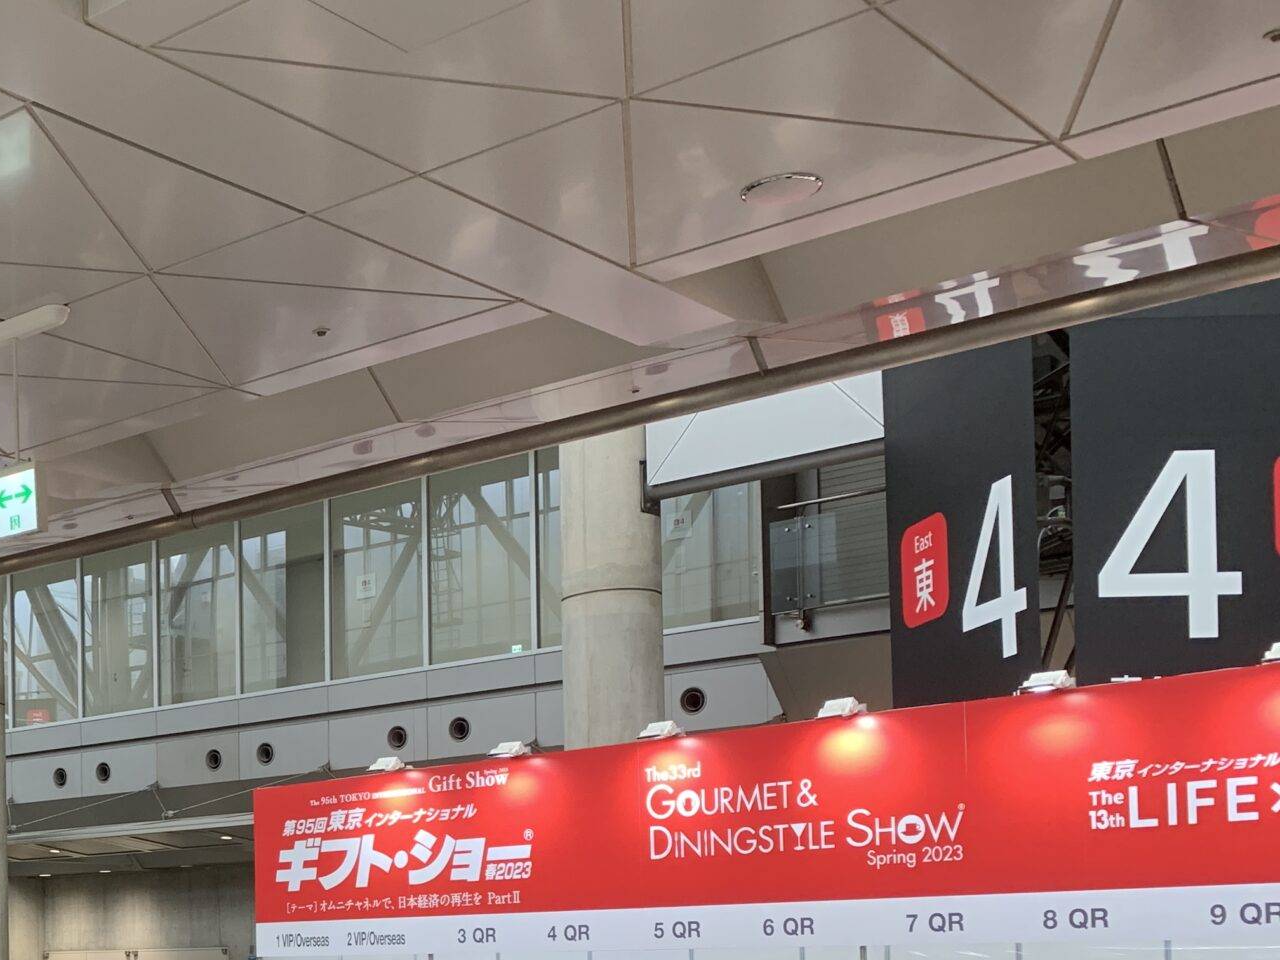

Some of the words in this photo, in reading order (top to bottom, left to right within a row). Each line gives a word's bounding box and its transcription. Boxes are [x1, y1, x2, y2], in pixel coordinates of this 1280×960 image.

[914, 530, 933, 555] East
[1098, 449, 1243, 639] 4
[962, 474, 1027, 659] 4
[914, 557, 936, 614] 東
[320, 796, 338, 805] 95th
[339, 792, 370, 803] TOKYO
[428, 775, 462, 793] Gift
[465, 771, 509, 789] Show
[646, 780, 793, 820] GOURMET
[797, 778, 819, 808] &
[1089, 791, 1124, 807] The
[1088, 810, 1125, 830] 13th
[867, 850, 917, 868] Spring
[922, 845, 963, 863] 2023
[485, 861, 533, 881] 春2023
[906, 914, 918, 933] 7
[928, 912, 964, 933] QR
[1043, 909, 1058, 929] 8
[1068, 908, 1109, 929] QR
[1210, 904, 1227, 925] 9
[1239, 902, 1280, 925] QR
[457, 929, 467, 944] 3
[472, 928, 497, 944] QR
[547, 925, 558, 942] 4
[564, 924, 590, 943] QR
[654, 922, 665, 939] 5
[672, 921, 701, 939] QR
[763, 918, 775, 936] 6
[782, 917, 815, 937] QR
[276, 935, 280, 947] 1
[281, 933, 329, 947] VIP/Overseas
[347, 933, 352, 946] 2
[354, 931, 406, 946] VIP/Overseas
